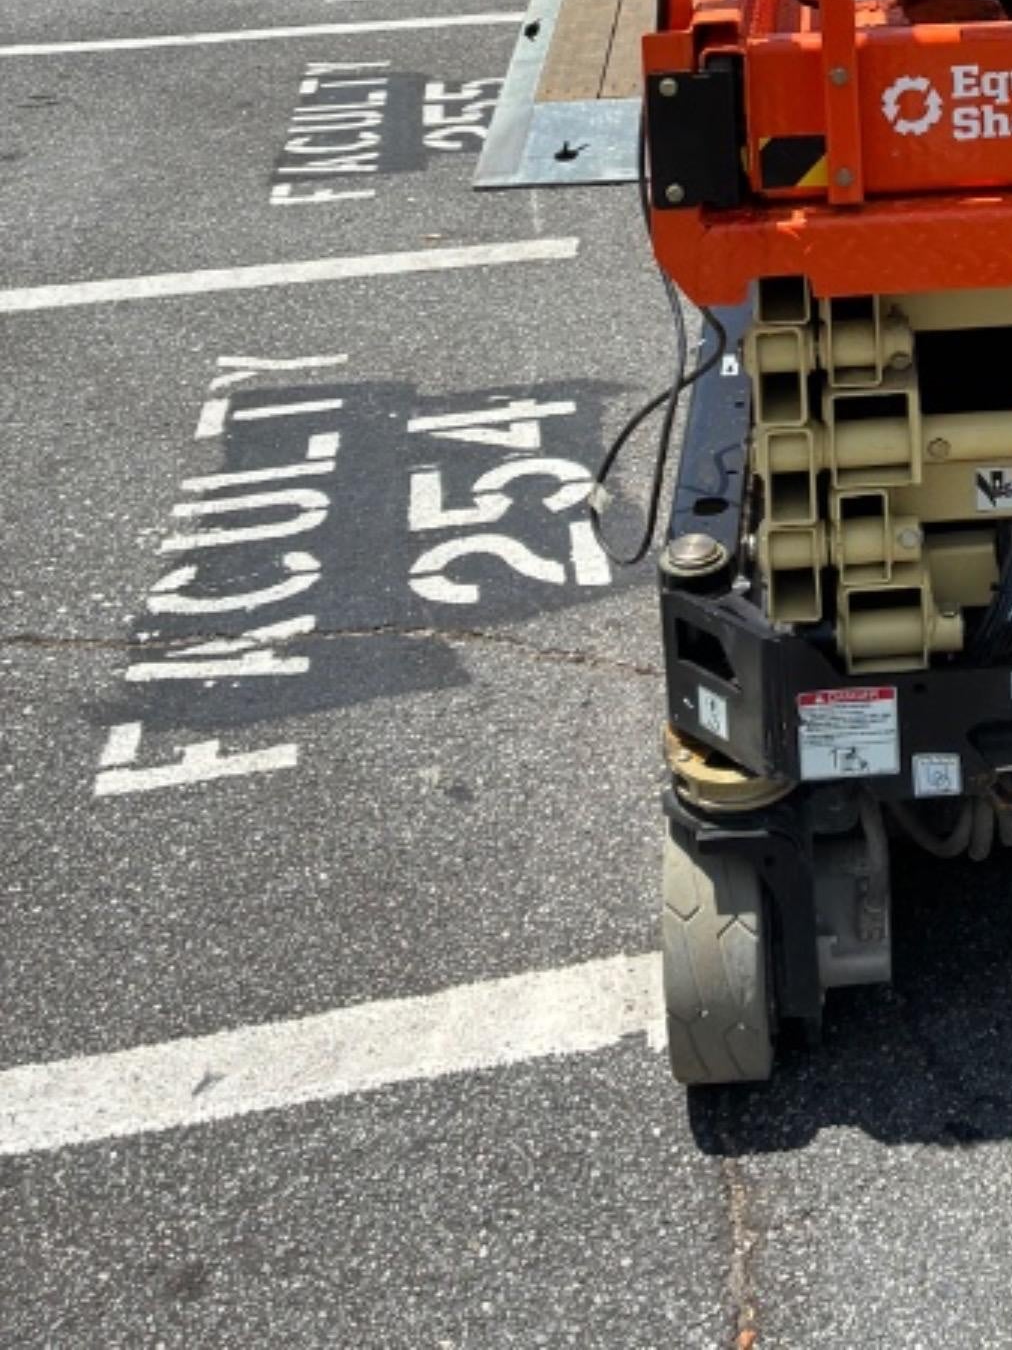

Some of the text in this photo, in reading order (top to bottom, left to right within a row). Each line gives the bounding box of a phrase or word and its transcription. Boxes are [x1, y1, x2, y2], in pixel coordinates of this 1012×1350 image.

[269, 60, 391, 206] FACULTY
[94, 353, 349, 797] FACULTY
[406, 395, 612, 604] 254
